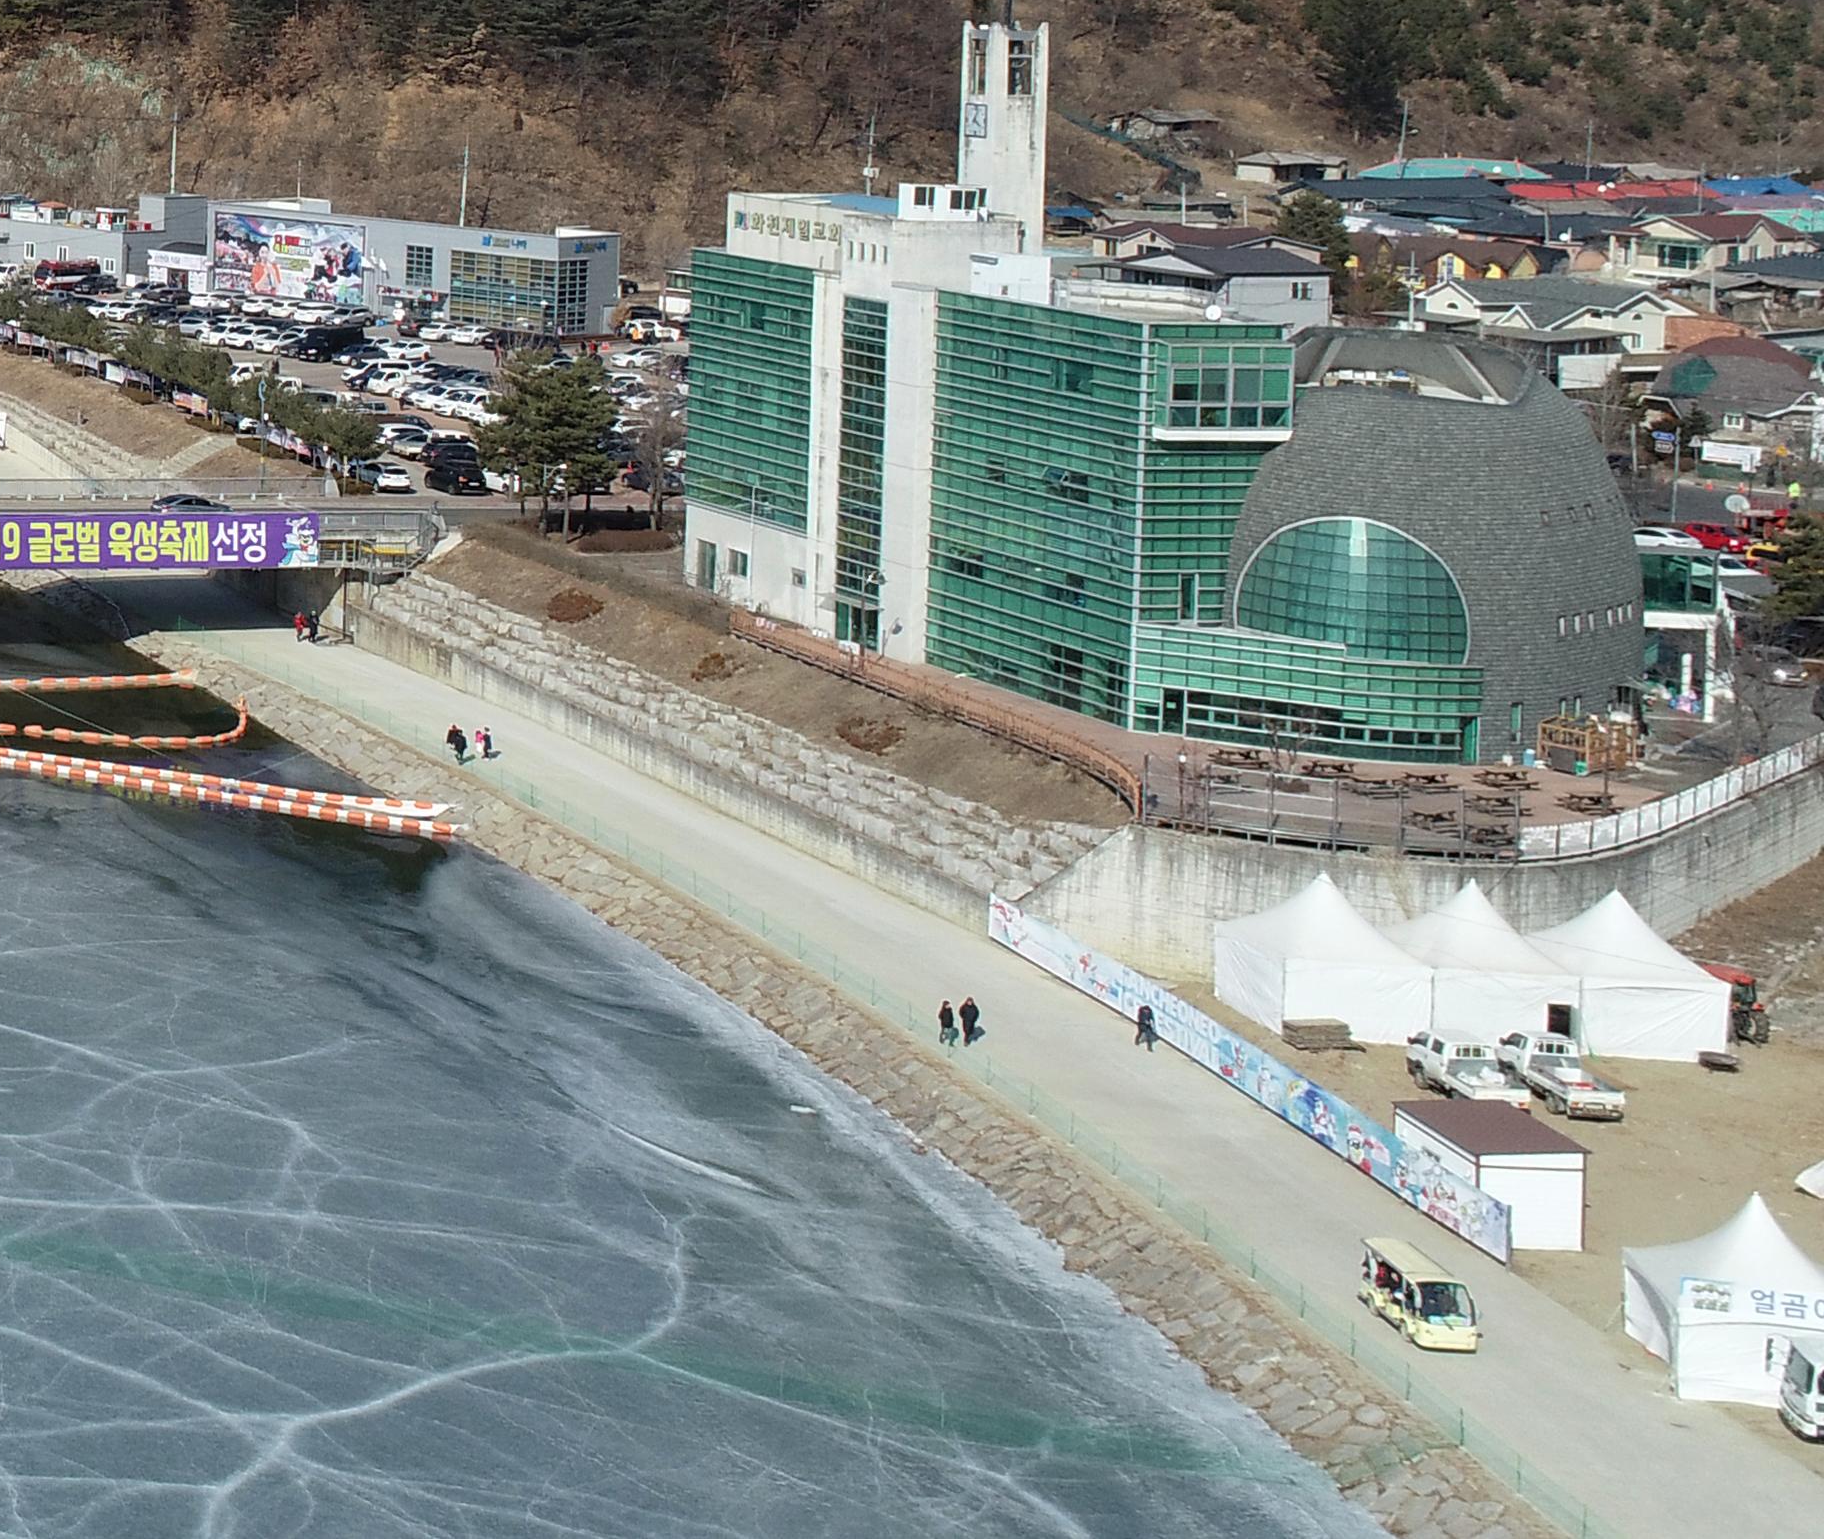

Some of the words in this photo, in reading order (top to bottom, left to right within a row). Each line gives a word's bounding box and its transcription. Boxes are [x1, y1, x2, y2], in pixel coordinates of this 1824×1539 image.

[751, 212, 843, 247] 화천제일교회
[28, 521, 101, 563] 글로벌
[108, 519, 209, 563] 육성축제
[212, 521, 267, 563] 선정
